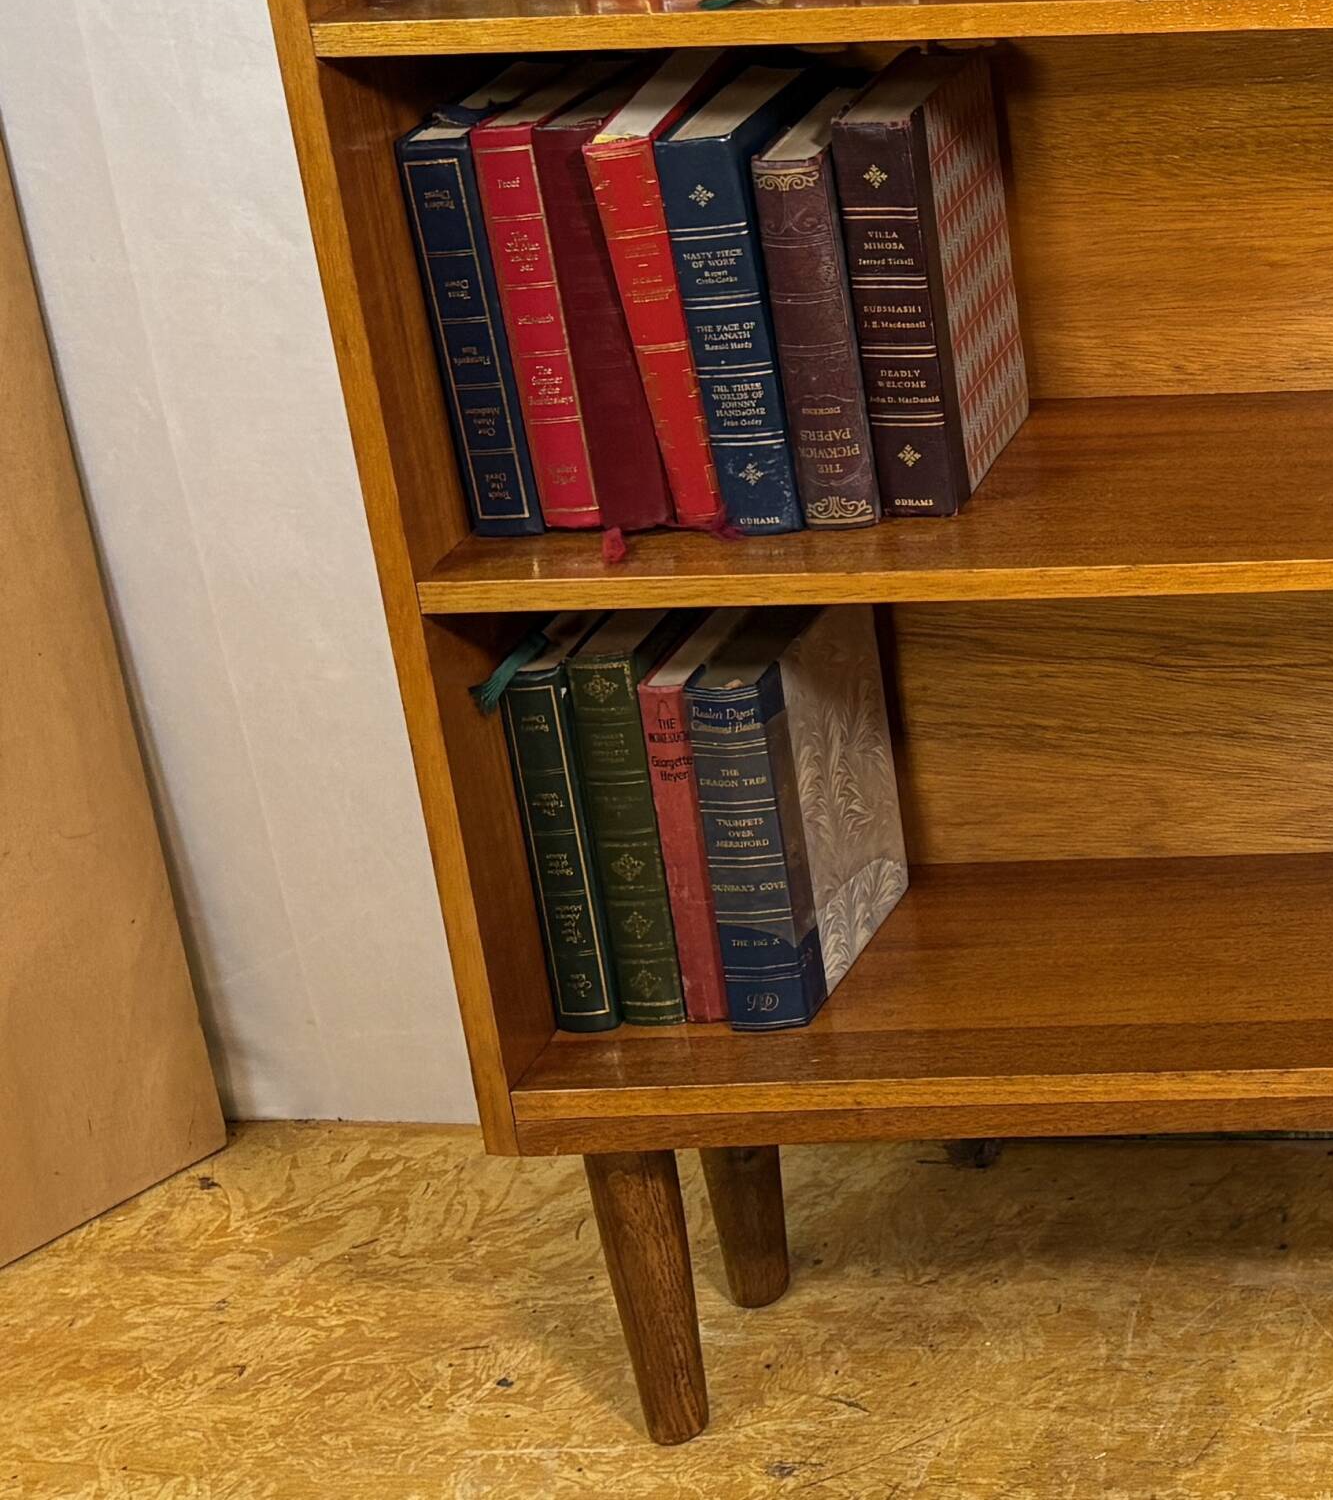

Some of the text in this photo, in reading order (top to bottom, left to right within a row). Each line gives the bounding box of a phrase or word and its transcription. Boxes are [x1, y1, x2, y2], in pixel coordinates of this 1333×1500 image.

[868, 230, 899, 240] VILLA
[863, 242, 905, 252] MIMOSA
[683, 247, 744, 261] NASTY PIECE
[692, 257, 737, 269] OF WORK
[696, 322, 756, 333] THE FACE OF
[880, 369, 921, 378] DEADLY
[732, 383, 762, 392] THREE
[877, 380, 928, 390] WELCOME
[721, 399, 758, 409] JOHNNY
[800, 428, 852, 441] PAPERS
[798, 443, 860, 459] PICKWICK
[817, 463, 843, 474] THE
[895, 499, 935, 507] ODHAMS
[725, 706, 756, 720] Digest
[658, 717, 677, 730] THE
[651, 755, 694, 769] Georgette
[660, 770, 689, 783] Heyer
[721, 768, 740, 777] THE
[742, 776, 768, 786] TREE
[716, 817, 765, 828] TRUMPETS
[728, 830, 754, 838] OVER
[760, 881, 787, 892] COVE
[731, 938, 748, 948] THE
[771, 937, 781, 946] X
